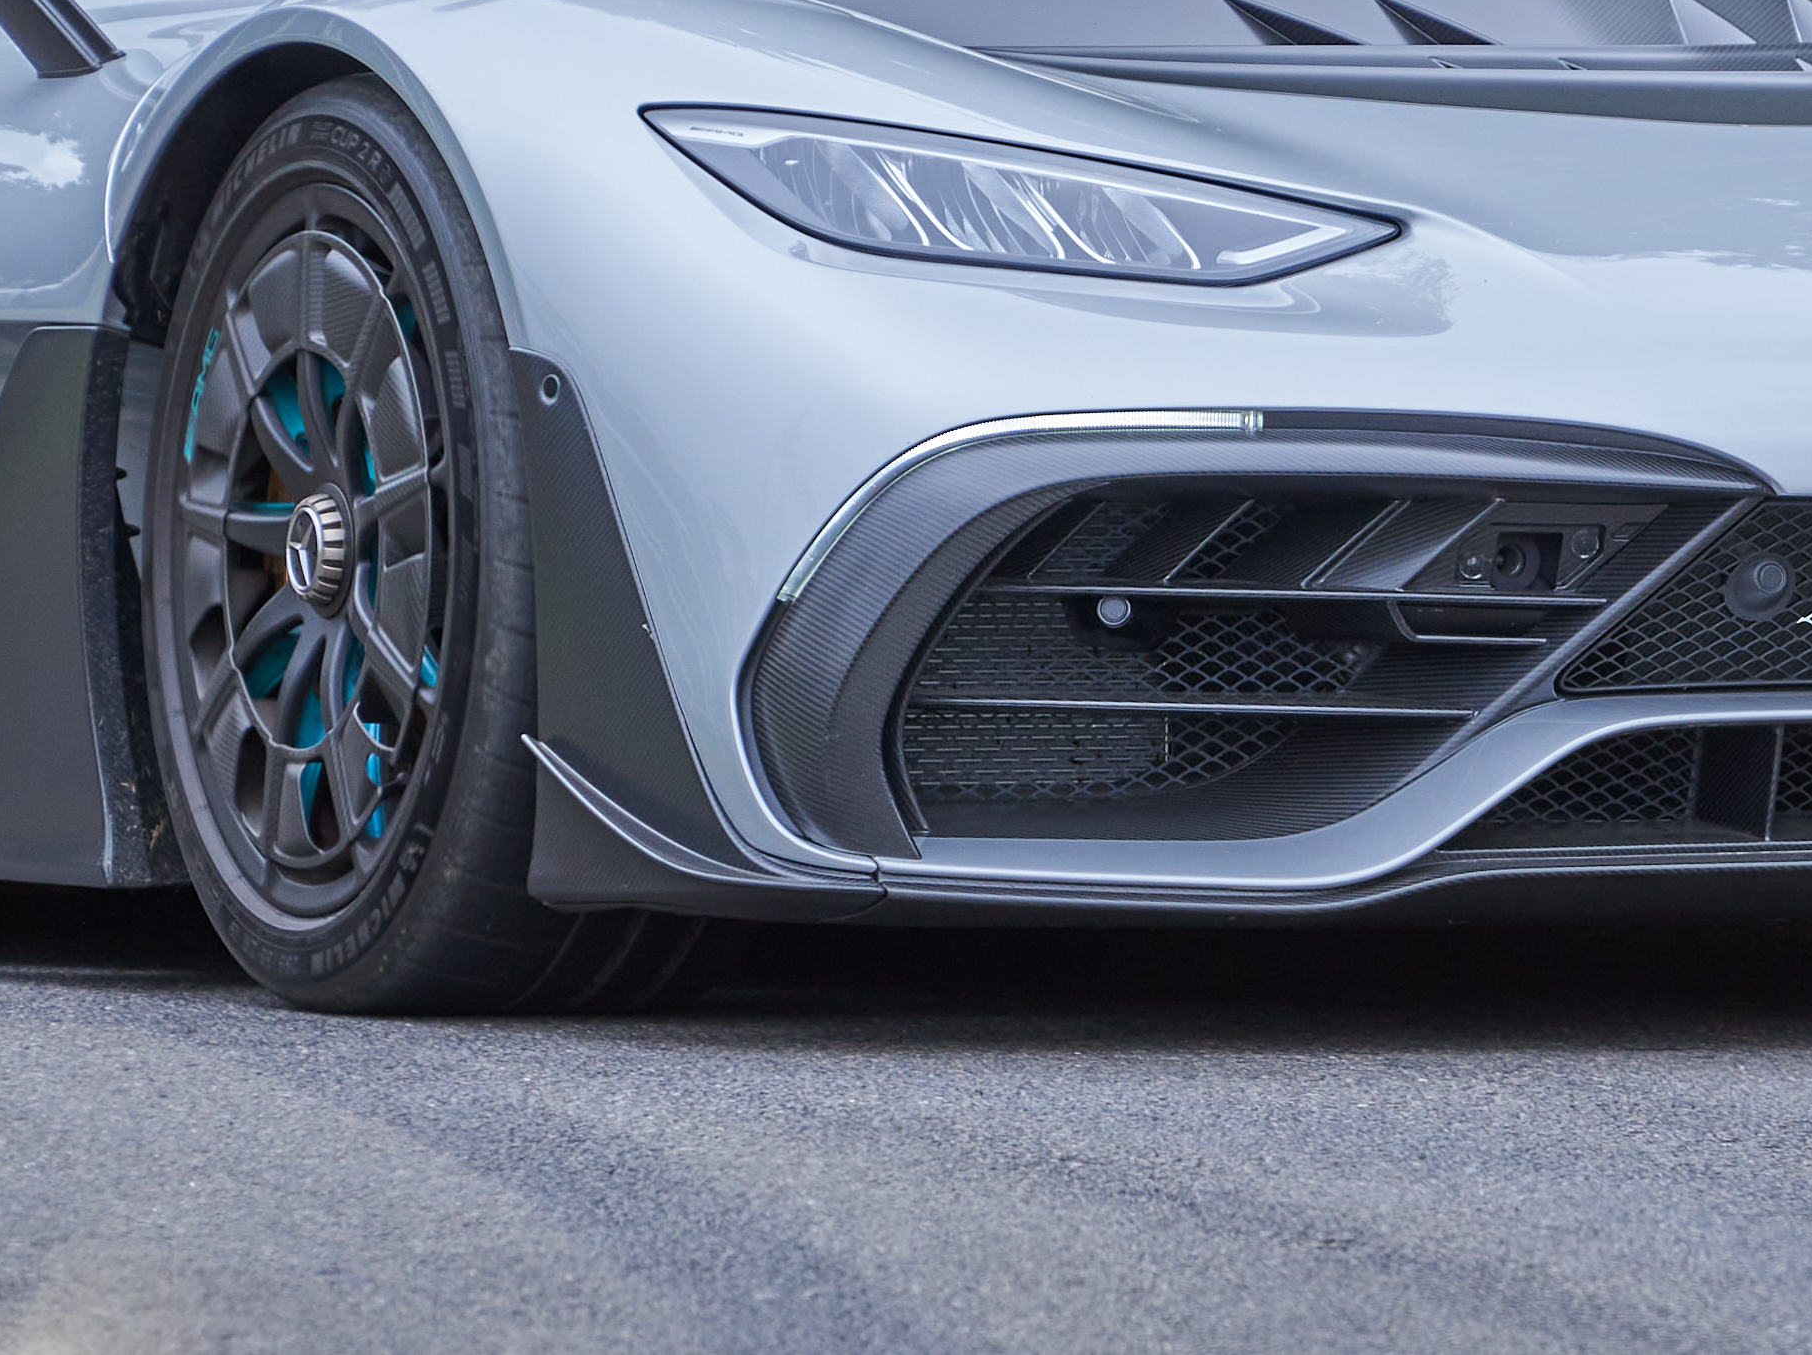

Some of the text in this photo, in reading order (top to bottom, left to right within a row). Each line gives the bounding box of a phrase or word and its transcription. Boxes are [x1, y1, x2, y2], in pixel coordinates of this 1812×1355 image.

[330, 125, 360, 150] CUP
[356, 141, 371, 161] 2
[367, 149, 382, 172] R
[310, 871, 406, 976] MICHELIN
